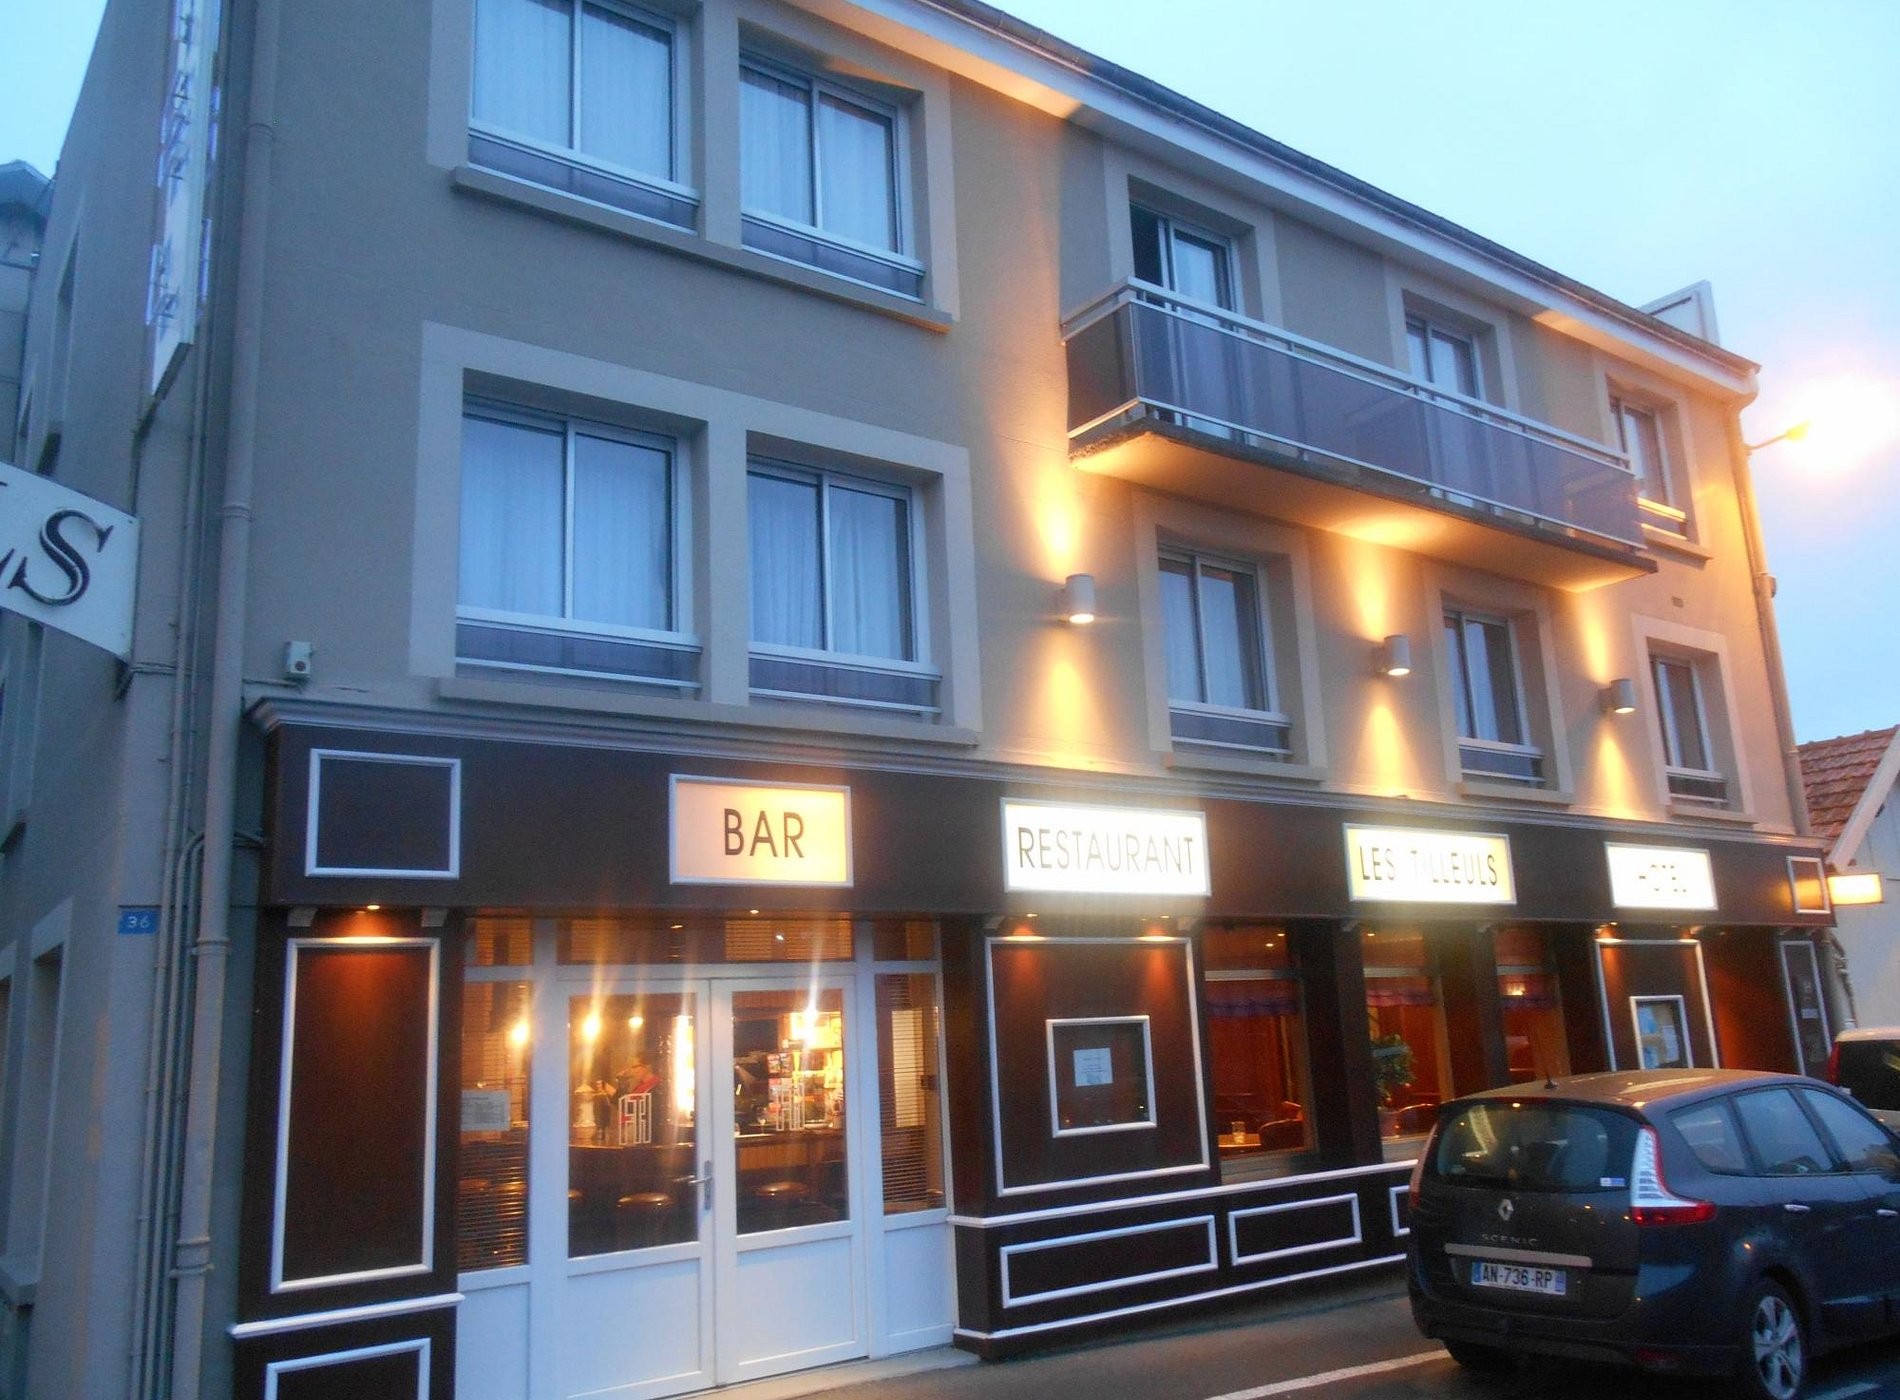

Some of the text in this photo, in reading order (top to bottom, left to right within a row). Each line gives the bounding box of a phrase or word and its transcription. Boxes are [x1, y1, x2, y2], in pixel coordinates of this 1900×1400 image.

[724, 808, 804, 858] BAR
[1017, 826, 1194, 874] RESTAURANT
[1359, 845, 1498, 886] LES TLLEULS
[127, 915, 150, 929] 36
[1481, 1262, 1553, 1290] AN-736-RP
